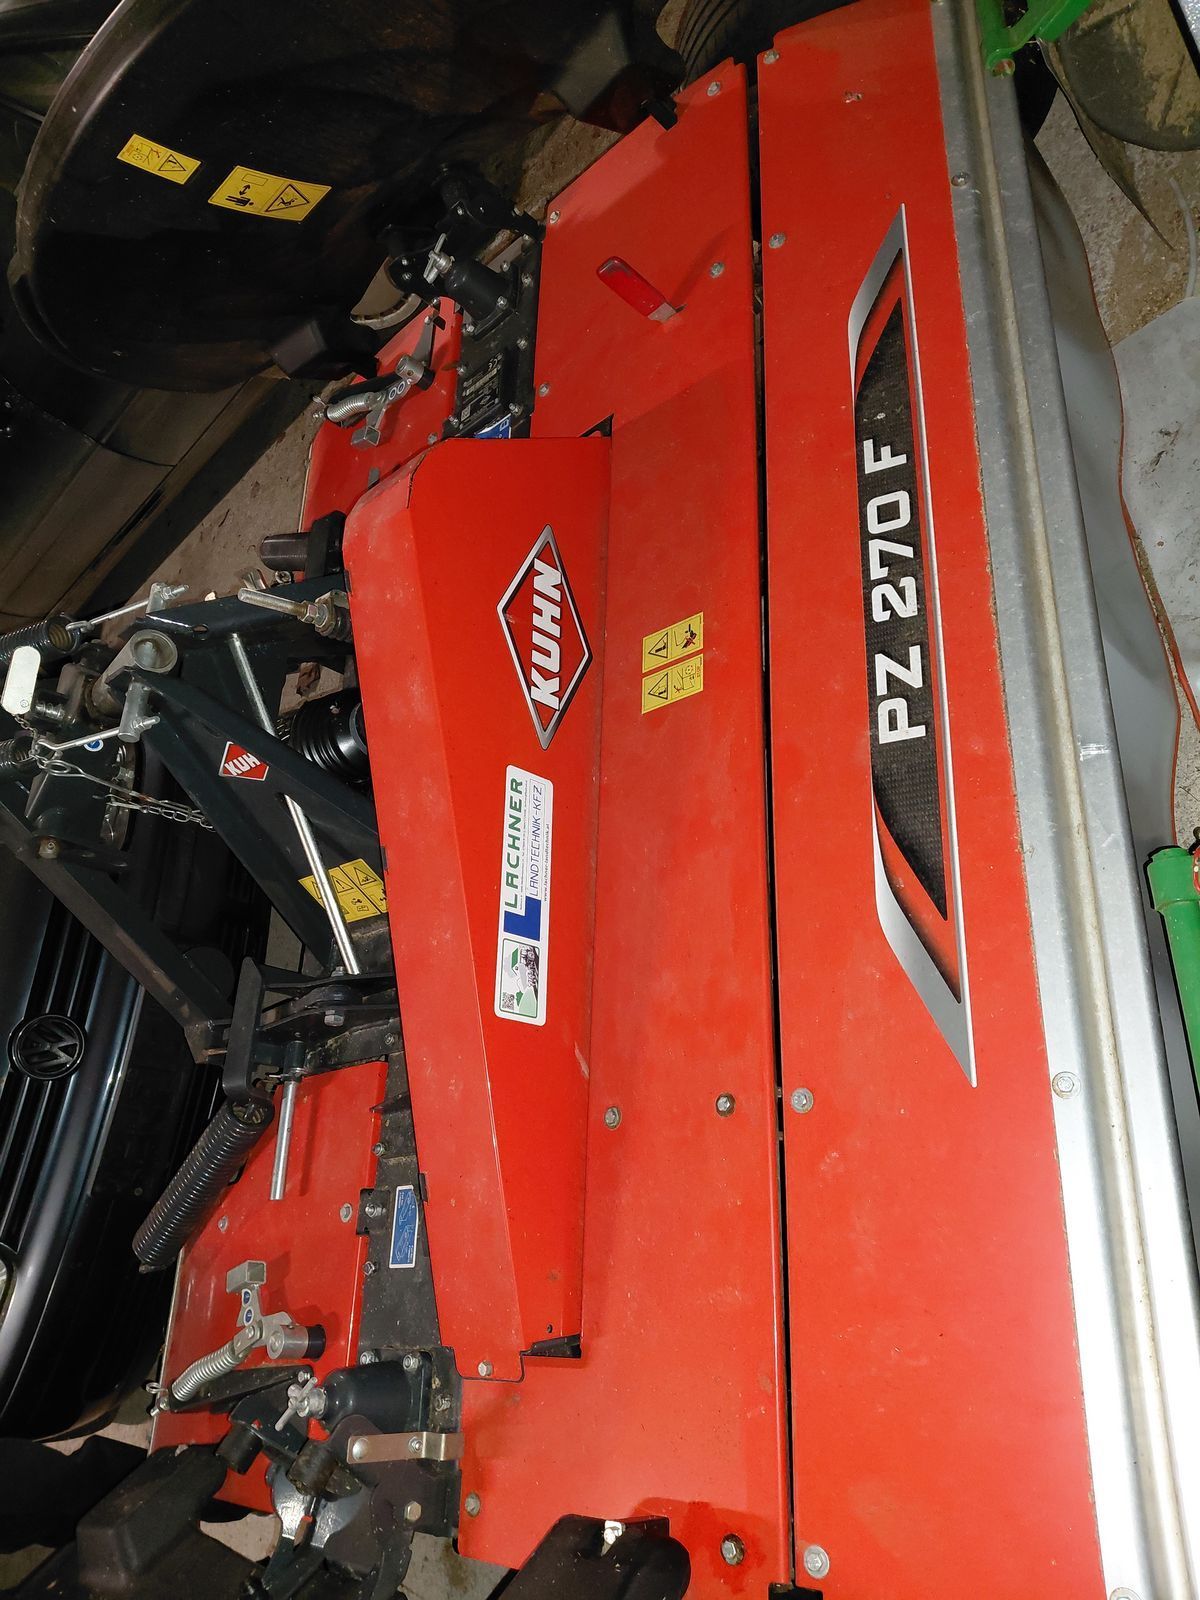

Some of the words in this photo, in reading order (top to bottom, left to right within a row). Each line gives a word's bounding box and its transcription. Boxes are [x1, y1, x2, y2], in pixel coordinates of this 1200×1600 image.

[863, 438, 907, 475] F
[866, 490, 918, 622] 270
[530, 557, 562, 711] KUHN
[874, 645, 926, 744] PZ
[224, 752, 261, 776] KUH
[504, 777, 523, 909] LACHNER
[529, 784, 542, 897] LANDTECHNIK-KFZ
